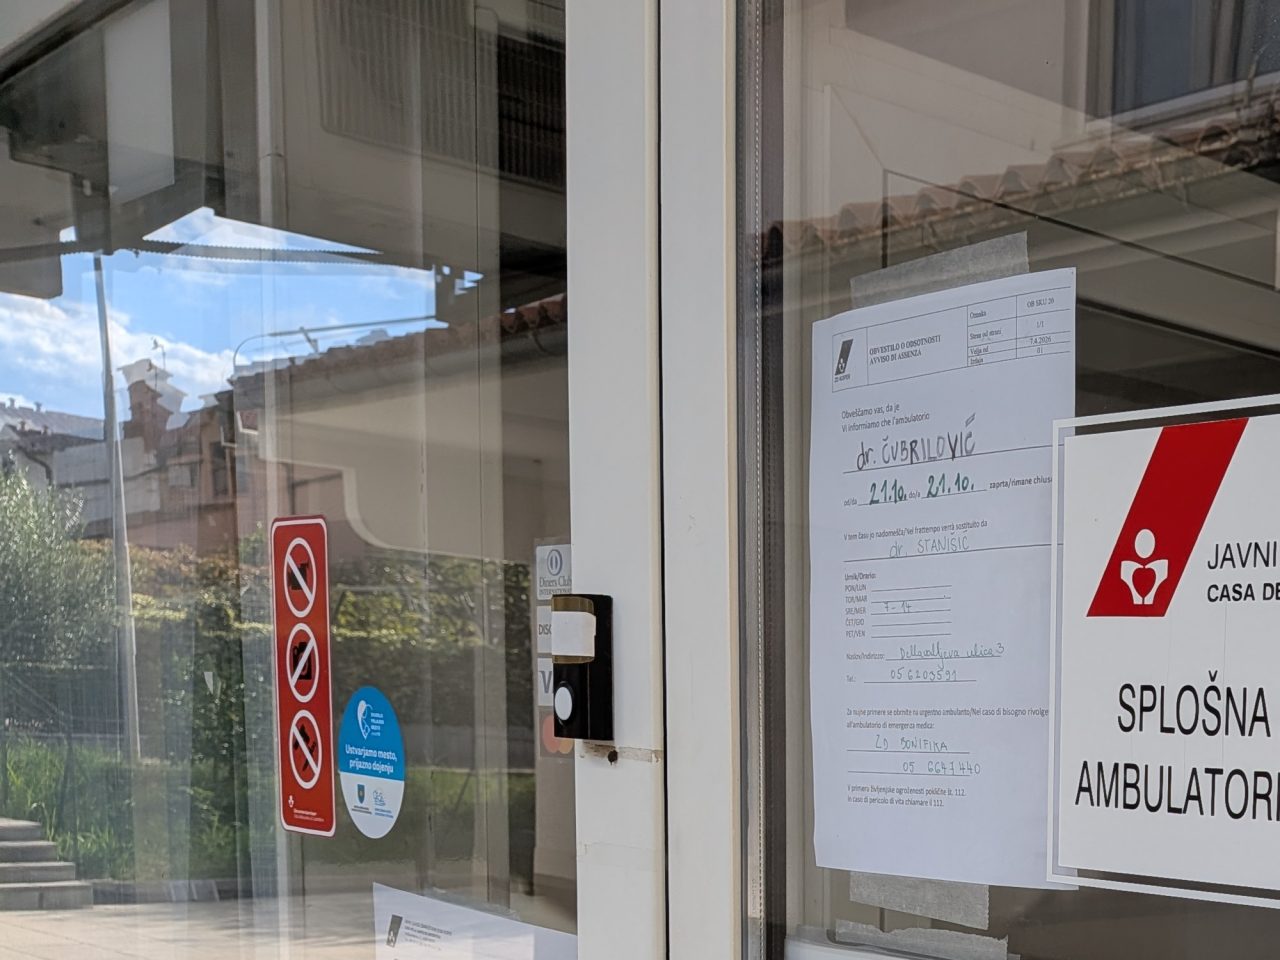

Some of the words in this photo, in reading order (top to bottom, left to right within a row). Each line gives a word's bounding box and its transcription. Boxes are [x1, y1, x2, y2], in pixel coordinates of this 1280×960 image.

[898, 349, 922, 361] ASSENZA
[856, 442, 877, 471] dr.
[1207, 541, 1277, 569] JAVNI
[1207, 583, 1255, 602] CASA
[1117, 672, 1271, 736] SPLOŠNA
